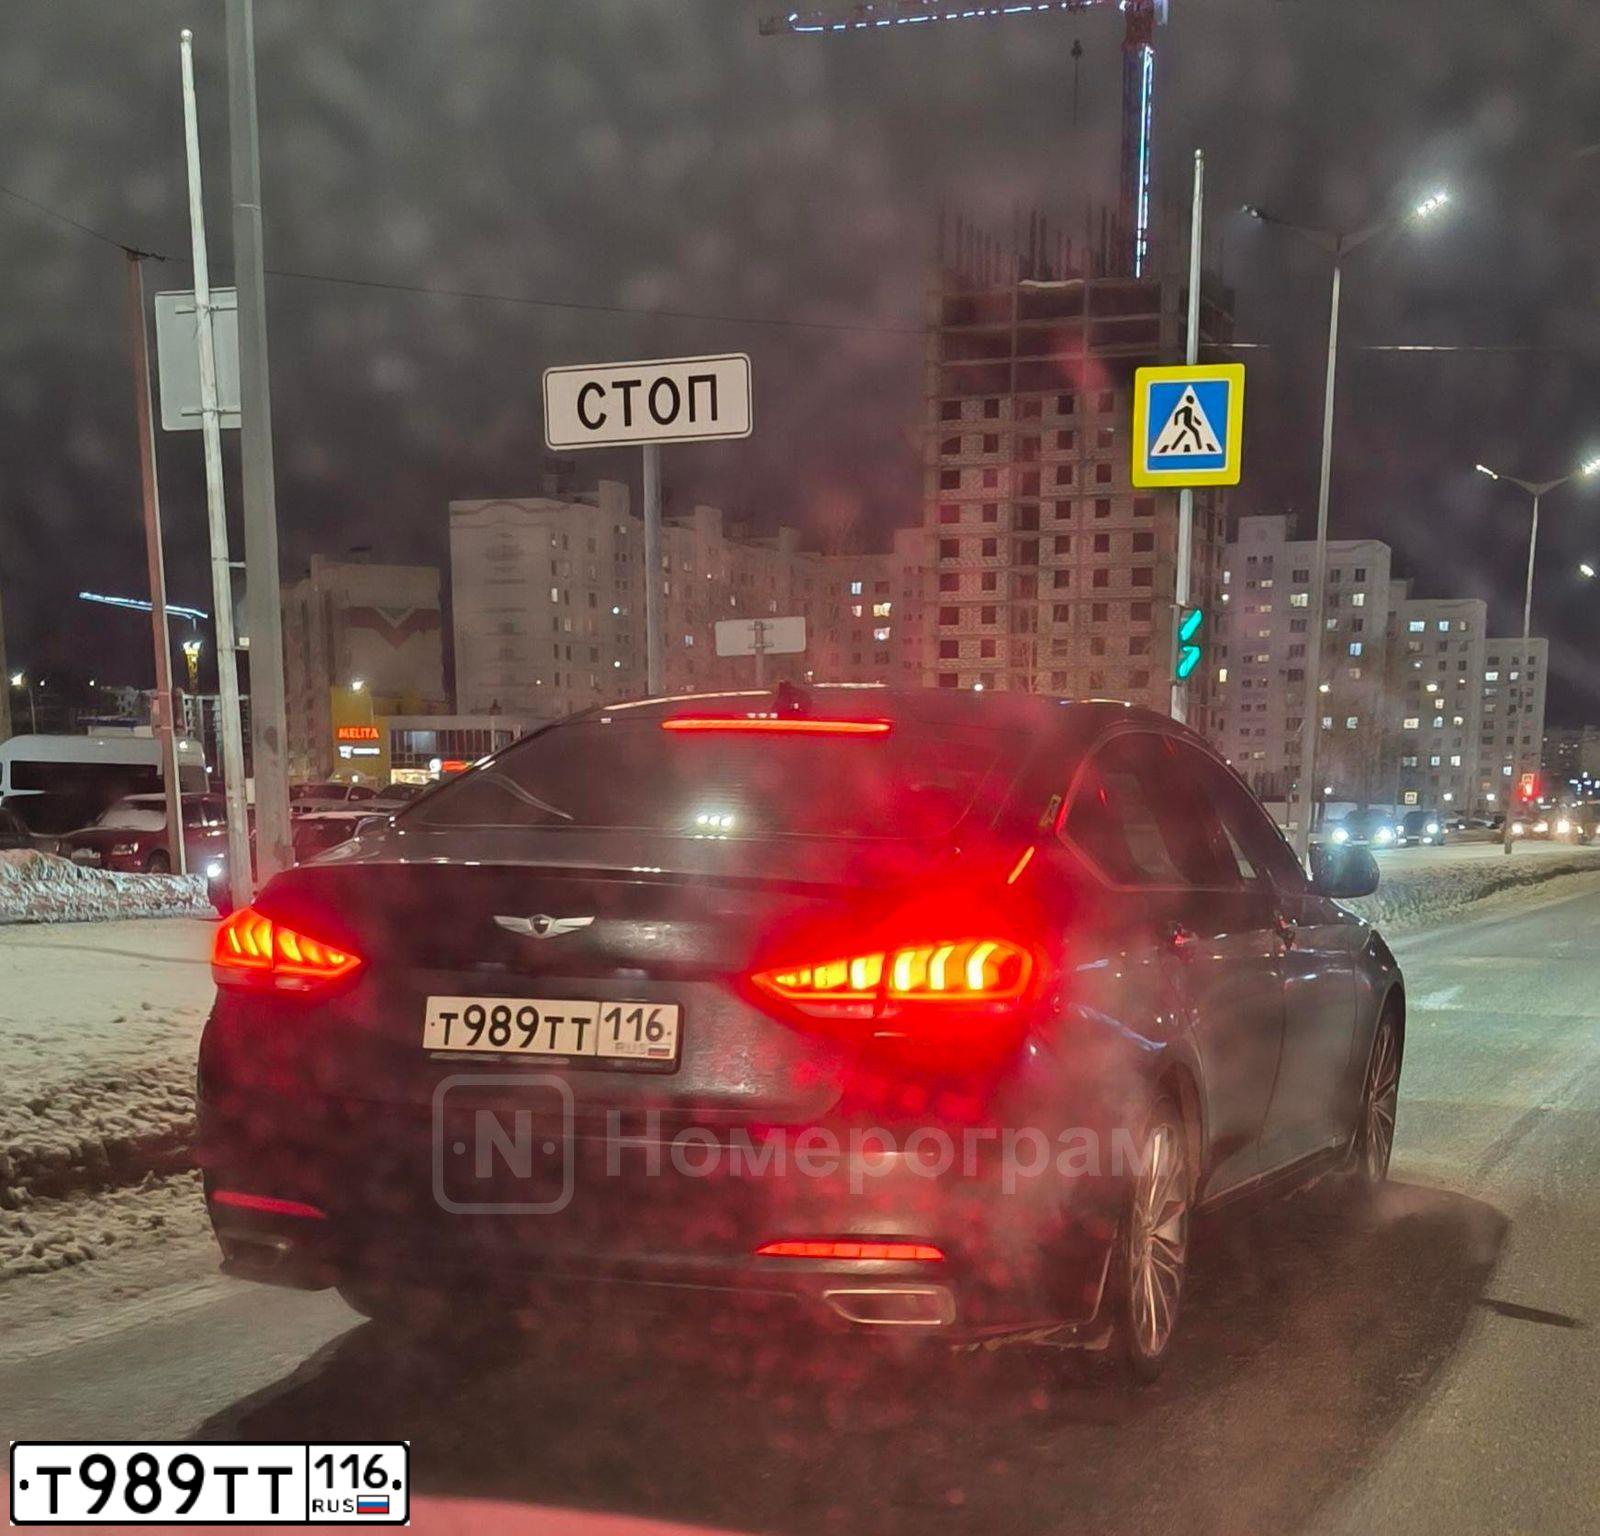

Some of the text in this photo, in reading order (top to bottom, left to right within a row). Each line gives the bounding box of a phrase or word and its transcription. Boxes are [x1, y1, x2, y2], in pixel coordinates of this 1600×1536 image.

[577, 374, 718, 430] СТОП
[338, 727, 380, 739] MELITA
[438, 1004, 664, 1051] Т989ТТ 116
[614, 1042, 647, 1055] RUS
